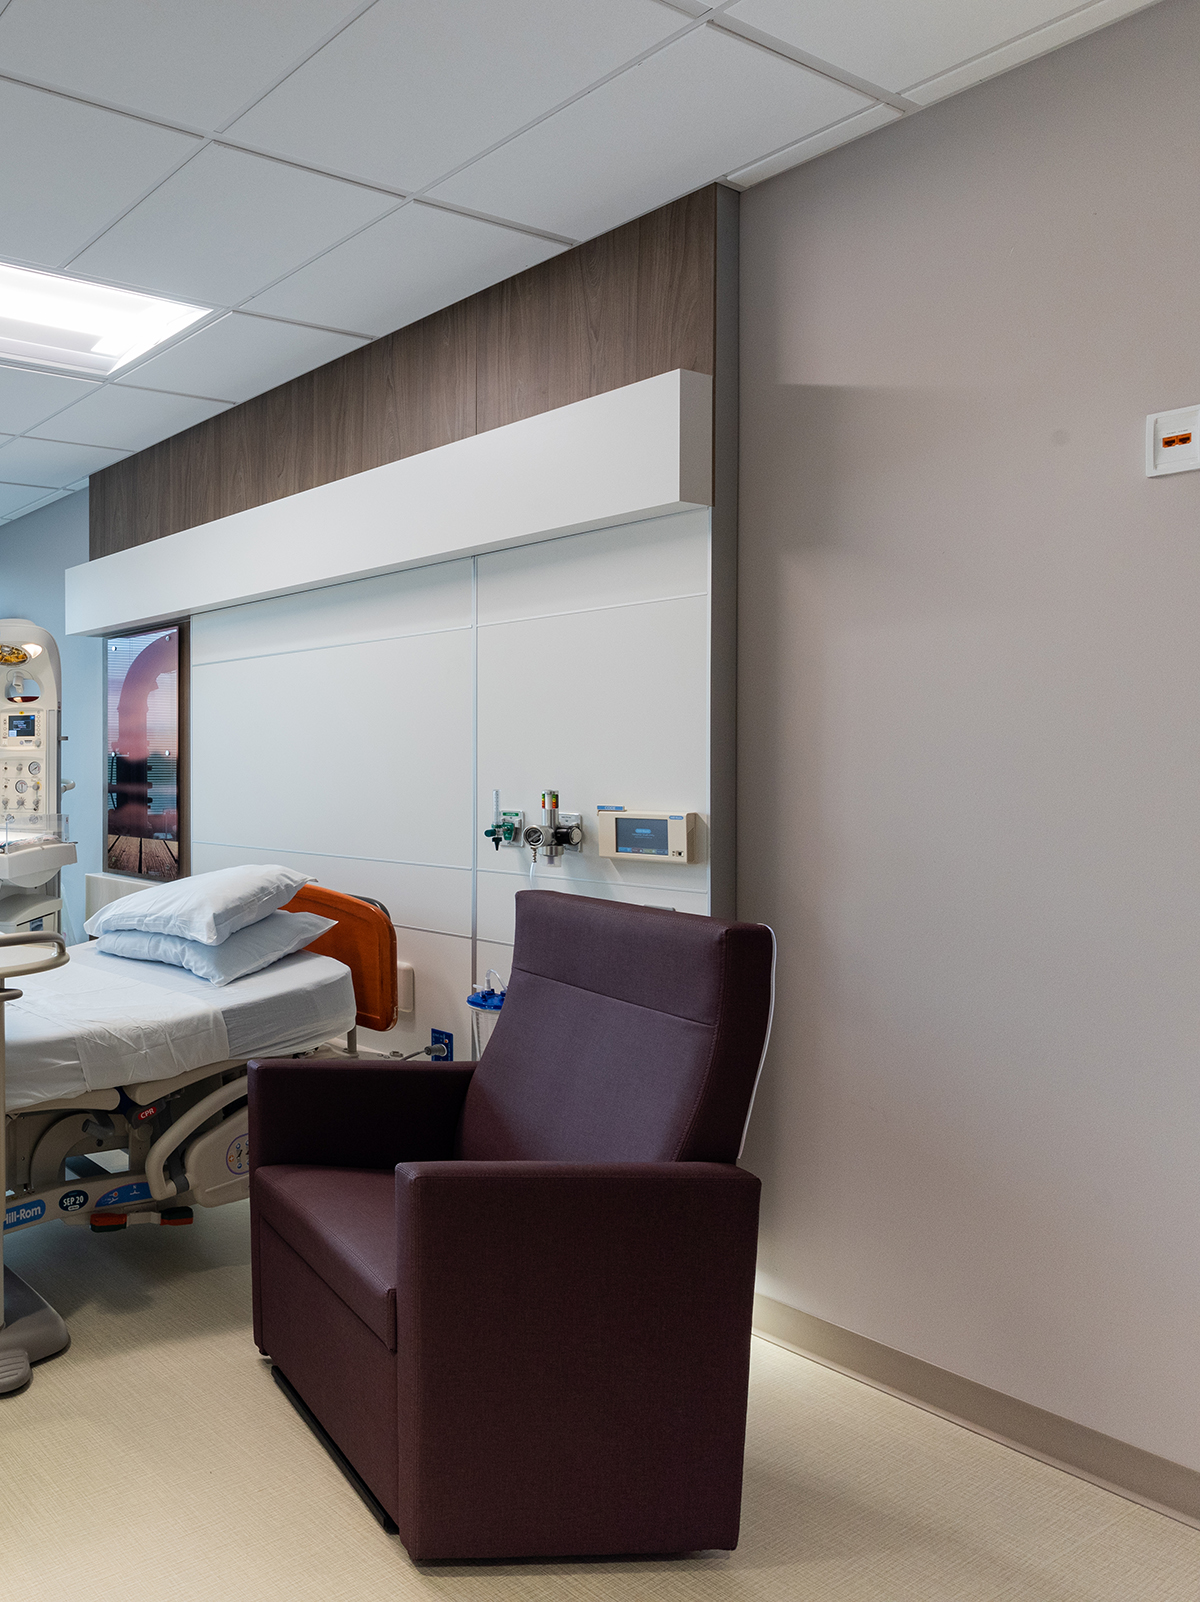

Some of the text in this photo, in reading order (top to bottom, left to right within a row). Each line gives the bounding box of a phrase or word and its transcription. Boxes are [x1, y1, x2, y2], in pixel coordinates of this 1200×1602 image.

[140, 1108, 155, 1119] CPR
[63, 1195, 84, 1207] SEP 20
